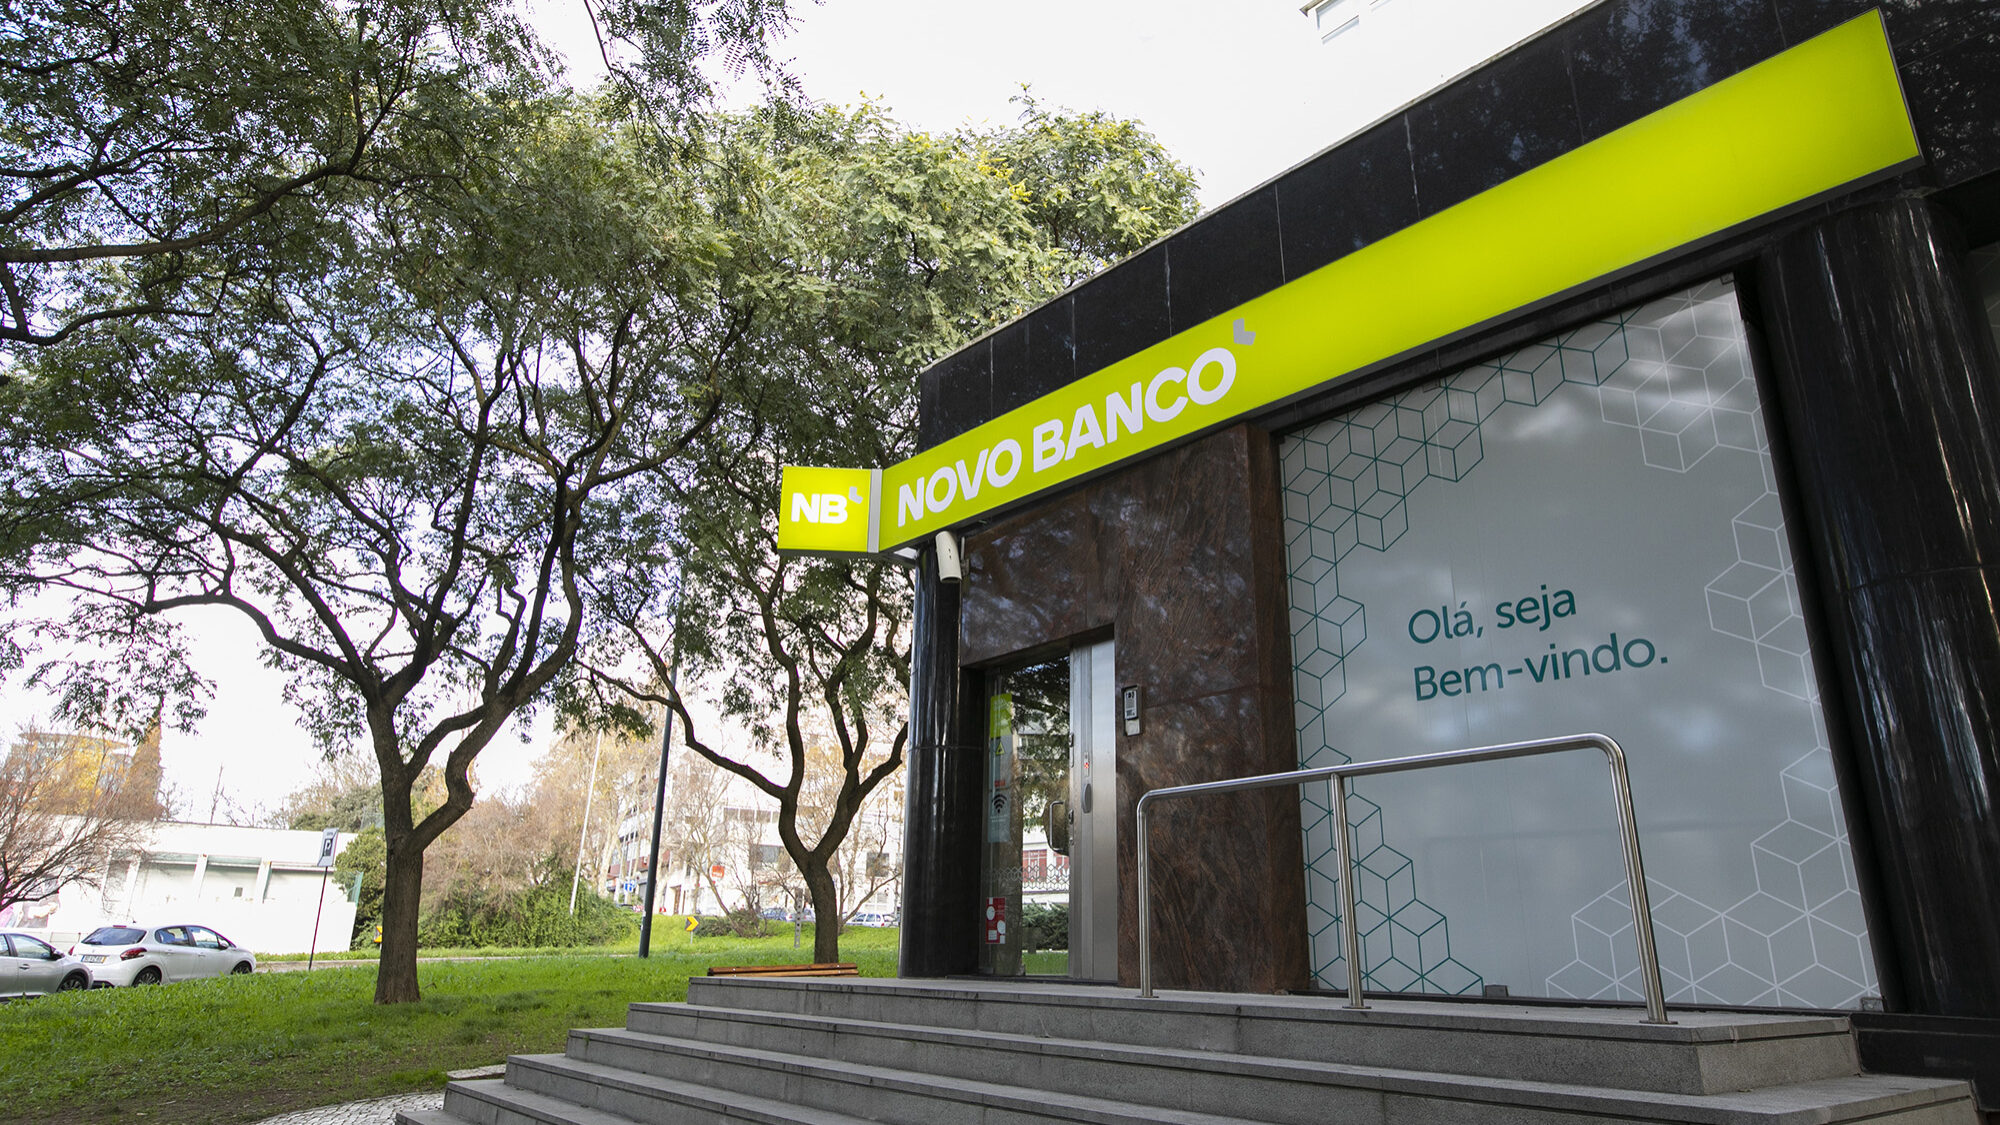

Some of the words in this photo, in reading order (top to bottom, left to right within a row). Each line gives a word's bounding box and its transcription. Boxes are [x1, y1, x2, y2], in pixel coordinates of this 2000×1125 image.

[897, 438, 1022, 527] NOVO
[1033, 347, 1237, 473] BANCO
[791, 492, 848, 524] NB
[1408, 601, 1483, 644] Olá,
[1495, 584, 1576, 632] seja
[1413, 632, 1668, 701] Bem-vindo.
